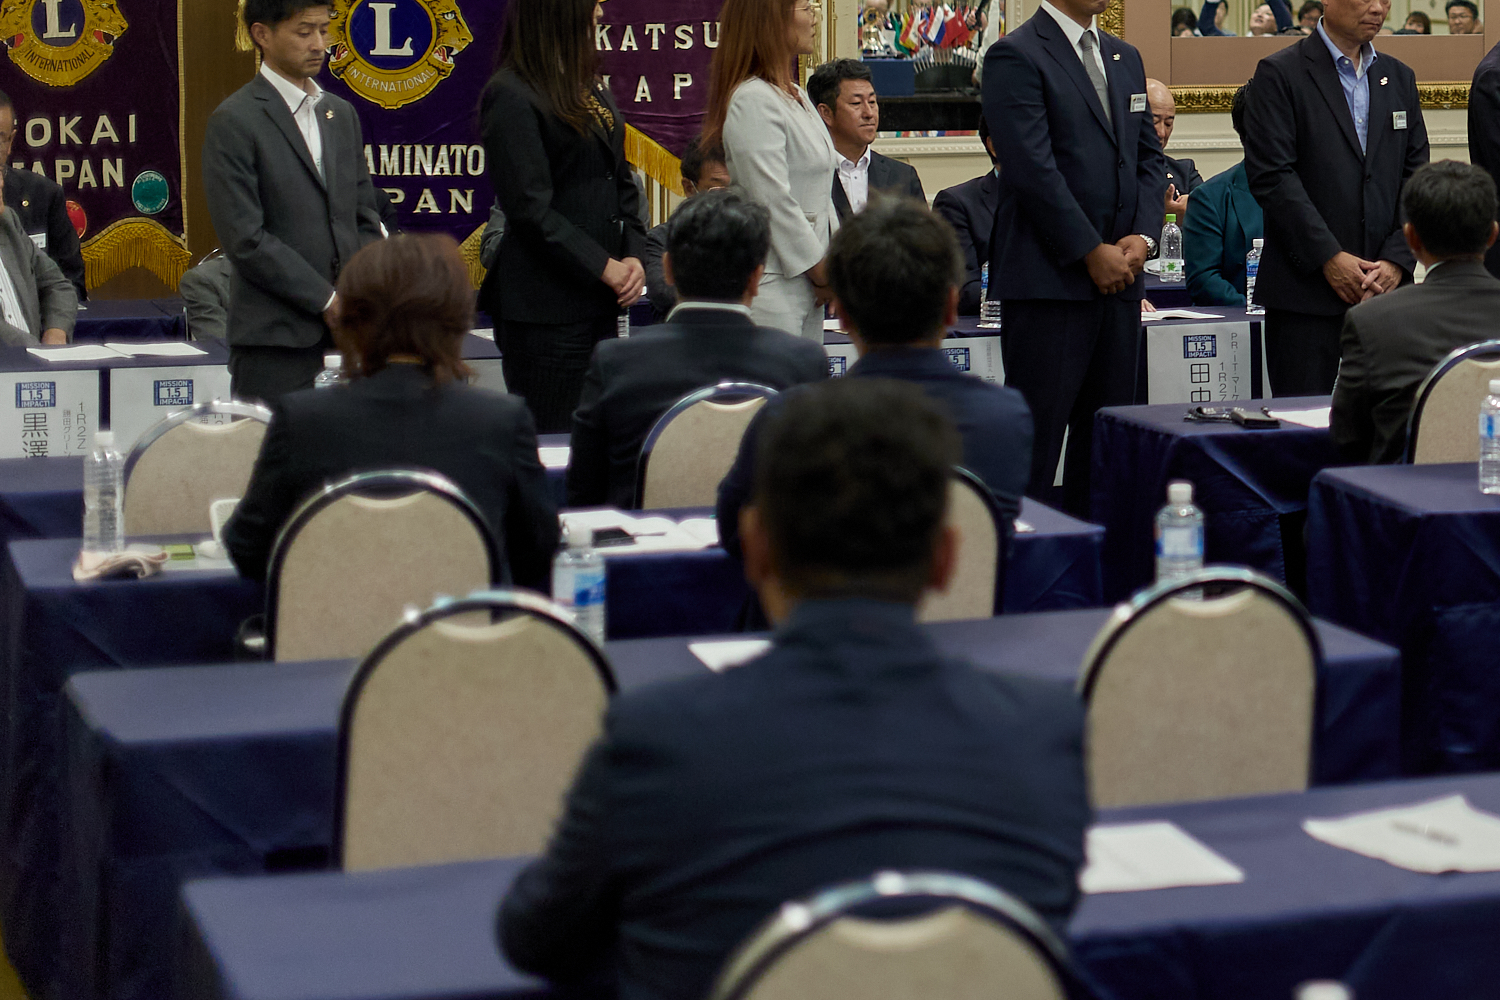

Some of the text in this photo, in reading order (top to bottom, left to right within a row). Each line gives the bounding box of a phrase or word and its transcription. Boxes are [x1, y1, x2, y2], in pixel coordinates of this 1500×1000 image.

[368, 2, 414, 57] L
[24, 48, 96, 73] INTERNATIONAL
[346, 65, 437, 93] INTERNATIONAL
[14, 113, 137, 147] OKAI
[1193, 342, 1207, 351] 1.5
[21, 382, 50, 390] MISSION
[28, 389, 43, 400] 1.5
[166, 387, 182, 398] 1.5
[76, 401, 87, 450] 1R2Z
